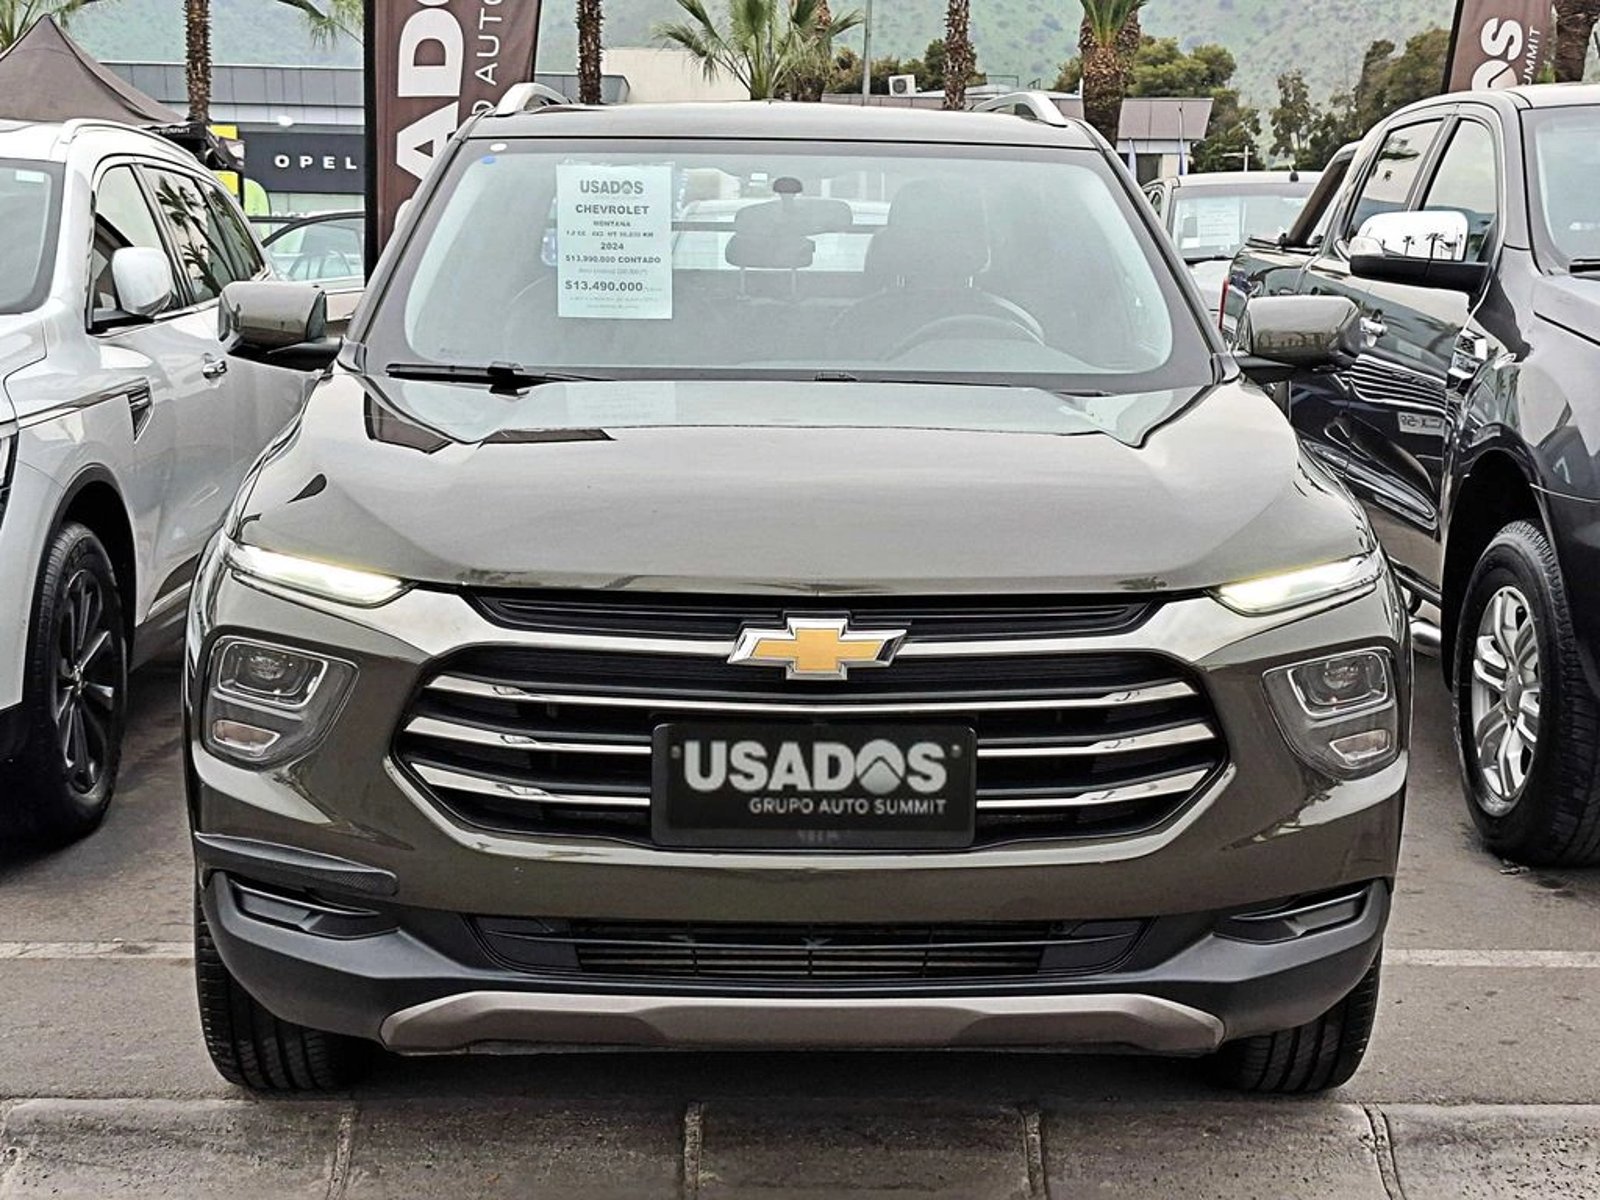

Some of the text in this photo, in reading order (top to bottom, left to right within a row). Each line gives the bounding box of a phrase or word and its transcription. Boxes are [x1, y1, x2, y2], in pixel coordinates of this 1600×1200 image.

[475, 0, 502, 86] AUT
[274, 154, 357, 169] OPEL
[580, 180, 644, 194] USADOS
[575, 204, 649, 215] CHEVROLET
[601, 242, 624, 250] 2024
[618, 256, 661, 264] CONTADO
[564, 280, 643, 292] $13.490.000
[684, 739, 947, 794] USADOS
[750, 797, 946, 816] GRUPO AUTO SUMMIT
